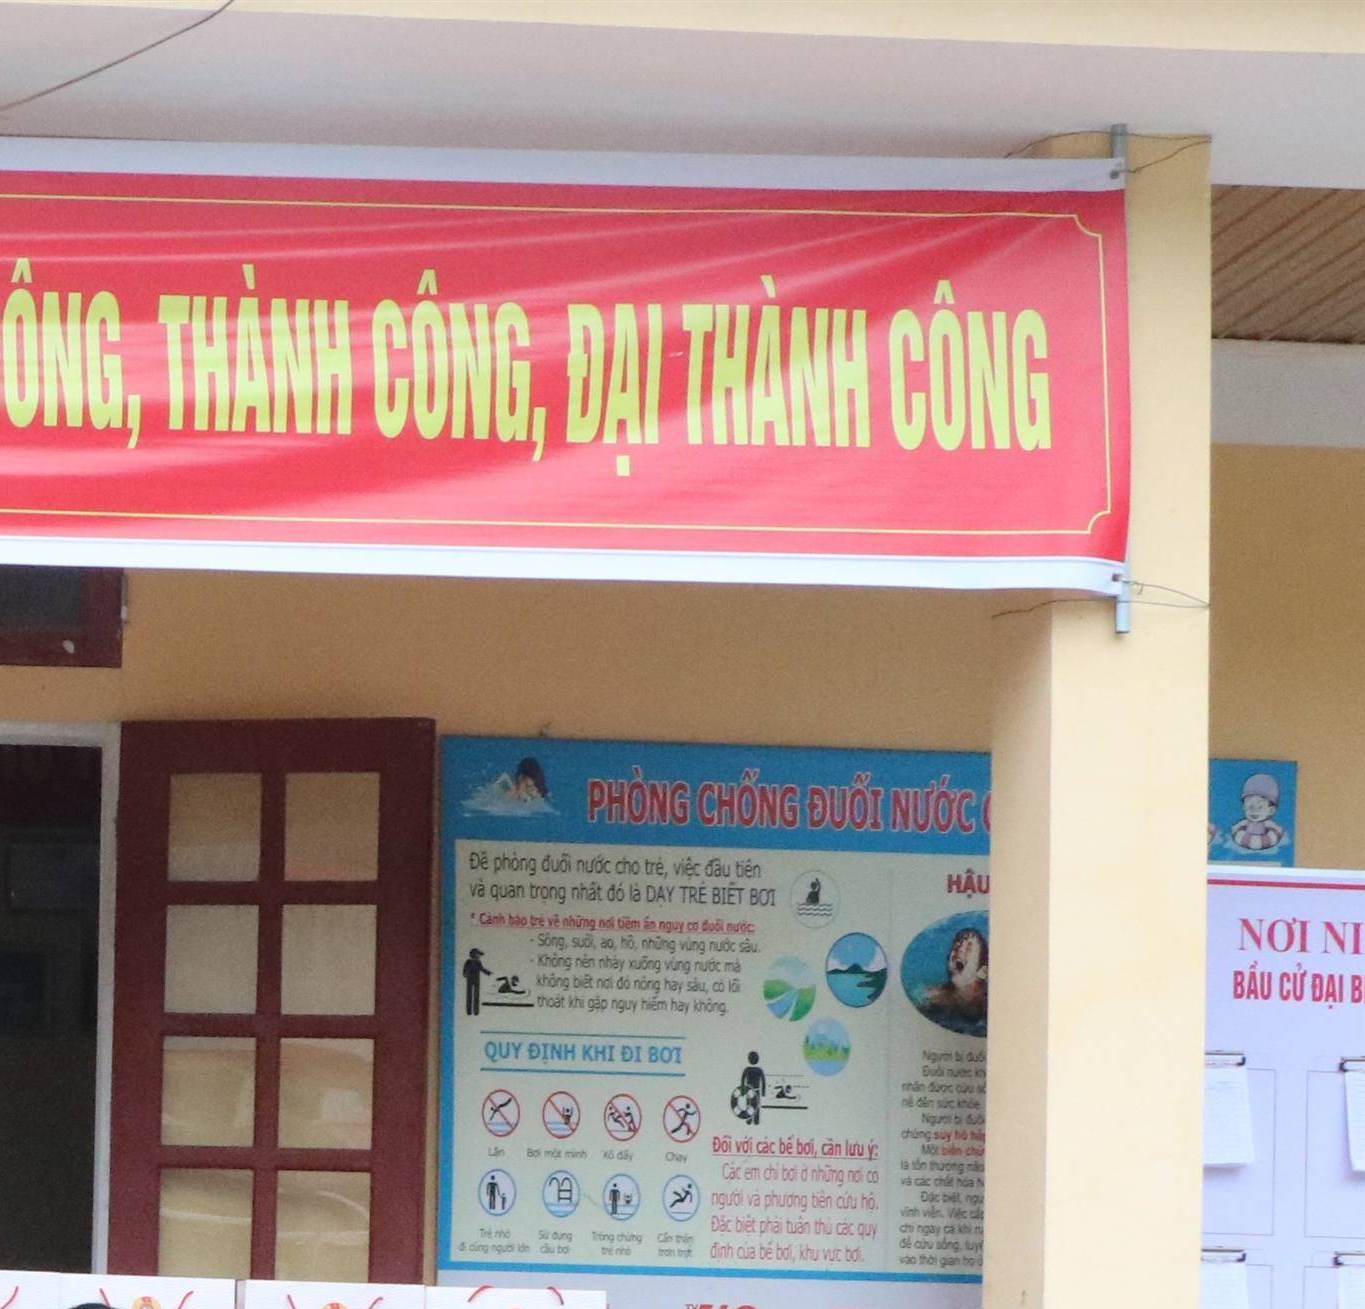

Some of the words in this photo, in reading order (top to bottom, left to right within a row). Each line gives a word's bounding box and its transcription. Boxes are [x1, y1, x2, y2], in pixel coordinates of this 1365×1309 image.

[158, 263, 352, 435] THÀNH
[371, 268, 546, 461] CÔNG,
[567, 302, 662, 476] ĐẠI
[681, 274, 871, 448] THÀNH
[888, 279, 1052, 451] CÔNG
[588, 765, 690, 825] PHÒNG
[697, 768, 798, 830] CHỐNG
[891, 775, 974, 833] NƯỚC
[1239, 917, 1309, 952] NƠI
[1233, 960, 1271, 1000] BẦU
[1279, 962, 1307, 1000] CỬ
[1311, 974, 1343, 1009] ĐẠI
[1351, 975, 1365, 1003] B
[485, 1041, 522, 1062] QUY
[528, 1042, 576, 1064] ĐỊNH
[582, 1045, 614, 1062] KHI
[621, 1046, 641, 1063] ĐI
[649, 1046, 682, 1064] BƠI
[712, 1135, 731, 1153] Đối
[736, 1136, 752, 1153] với
[756, 1136, 775, 1154] các
[779, 1134, 794, 1154] bể
[797, 1139, 817, 1158] bơi,
[821, 1137, 841, 1156] cần
[845, 1139, 864, 1157] lưu
[868, 1140, 878, 1161] ý:
